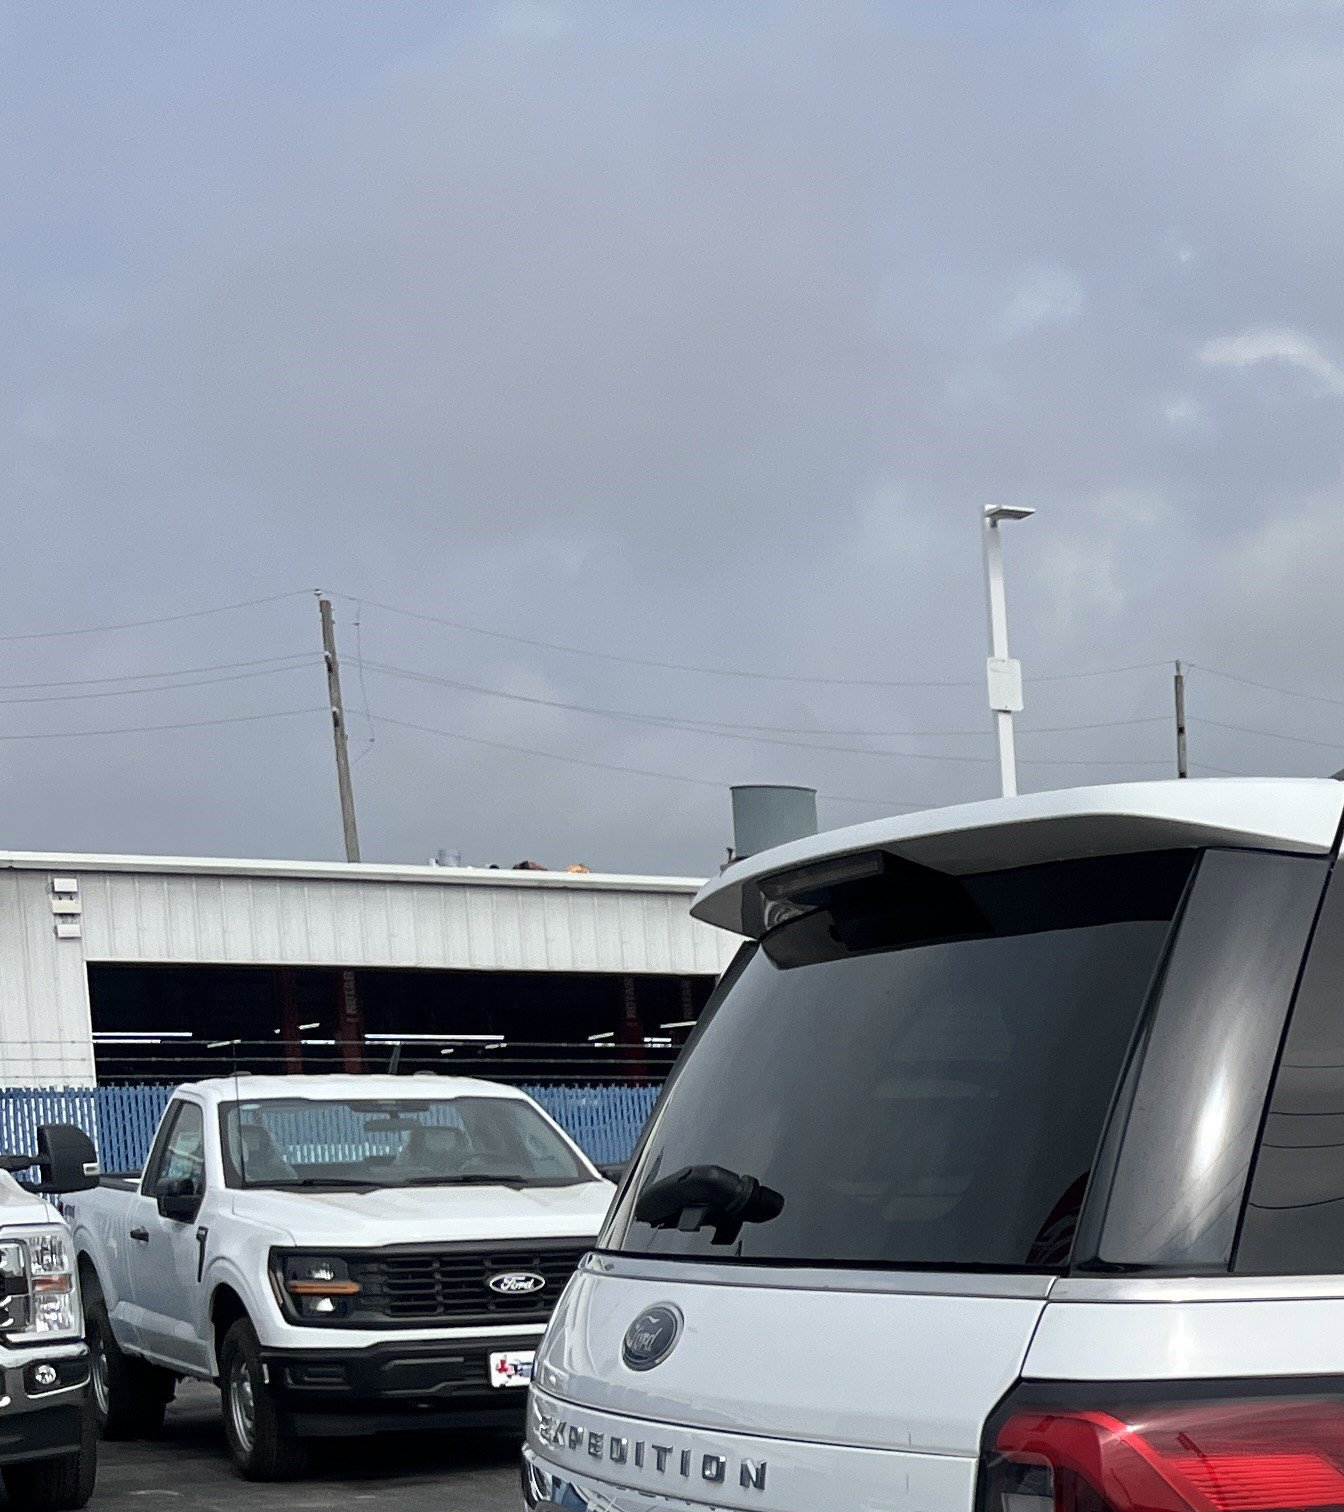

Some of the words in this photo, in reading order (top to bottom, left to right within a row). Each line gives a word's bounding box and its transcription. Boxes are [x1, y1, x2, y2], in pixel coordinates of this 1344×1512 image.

[500, 1275, 535, 1291] Ford
[627, 1315, 663, 1351] Ford
[541, 1416, 768, 1491] EXPEDITION
